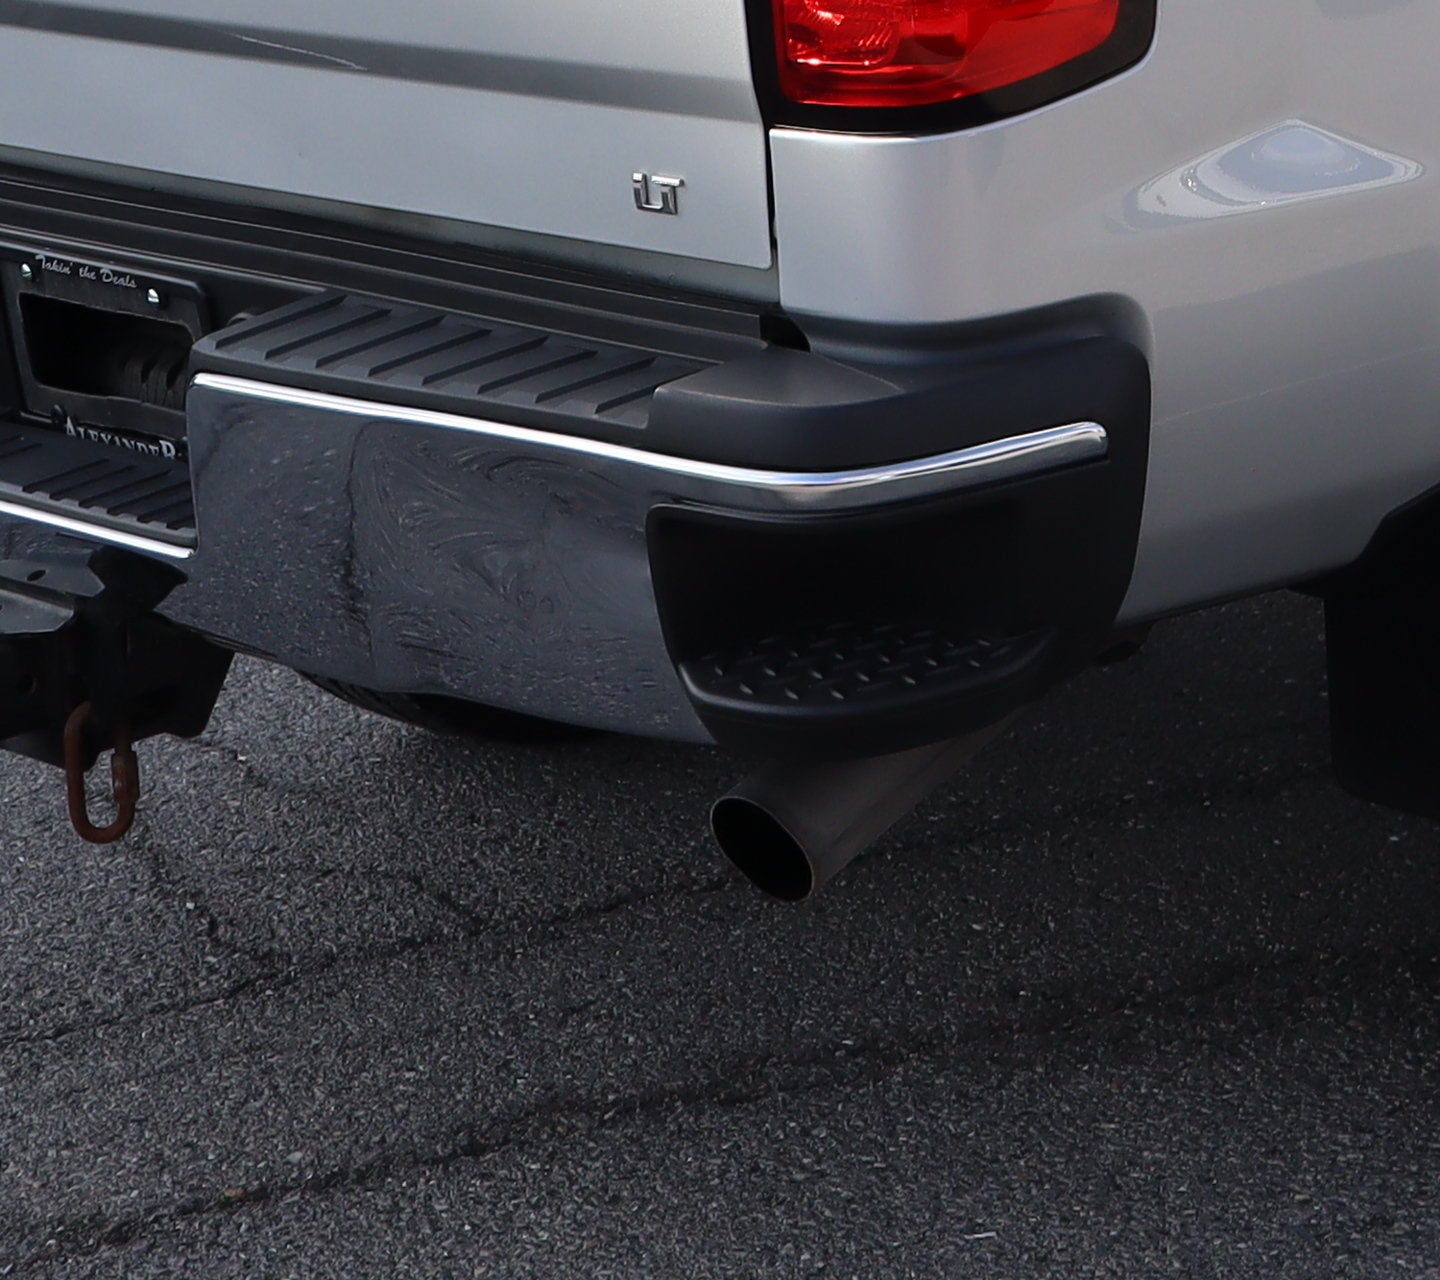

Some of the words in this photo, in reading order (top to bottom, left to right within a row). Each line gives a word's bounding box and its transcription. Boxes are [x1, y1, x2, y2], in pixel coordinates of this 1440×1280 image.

[632, 172, 685, 216] LT
[79, 266, 96, 280] the
[100, 267, 137, 289] Deals
